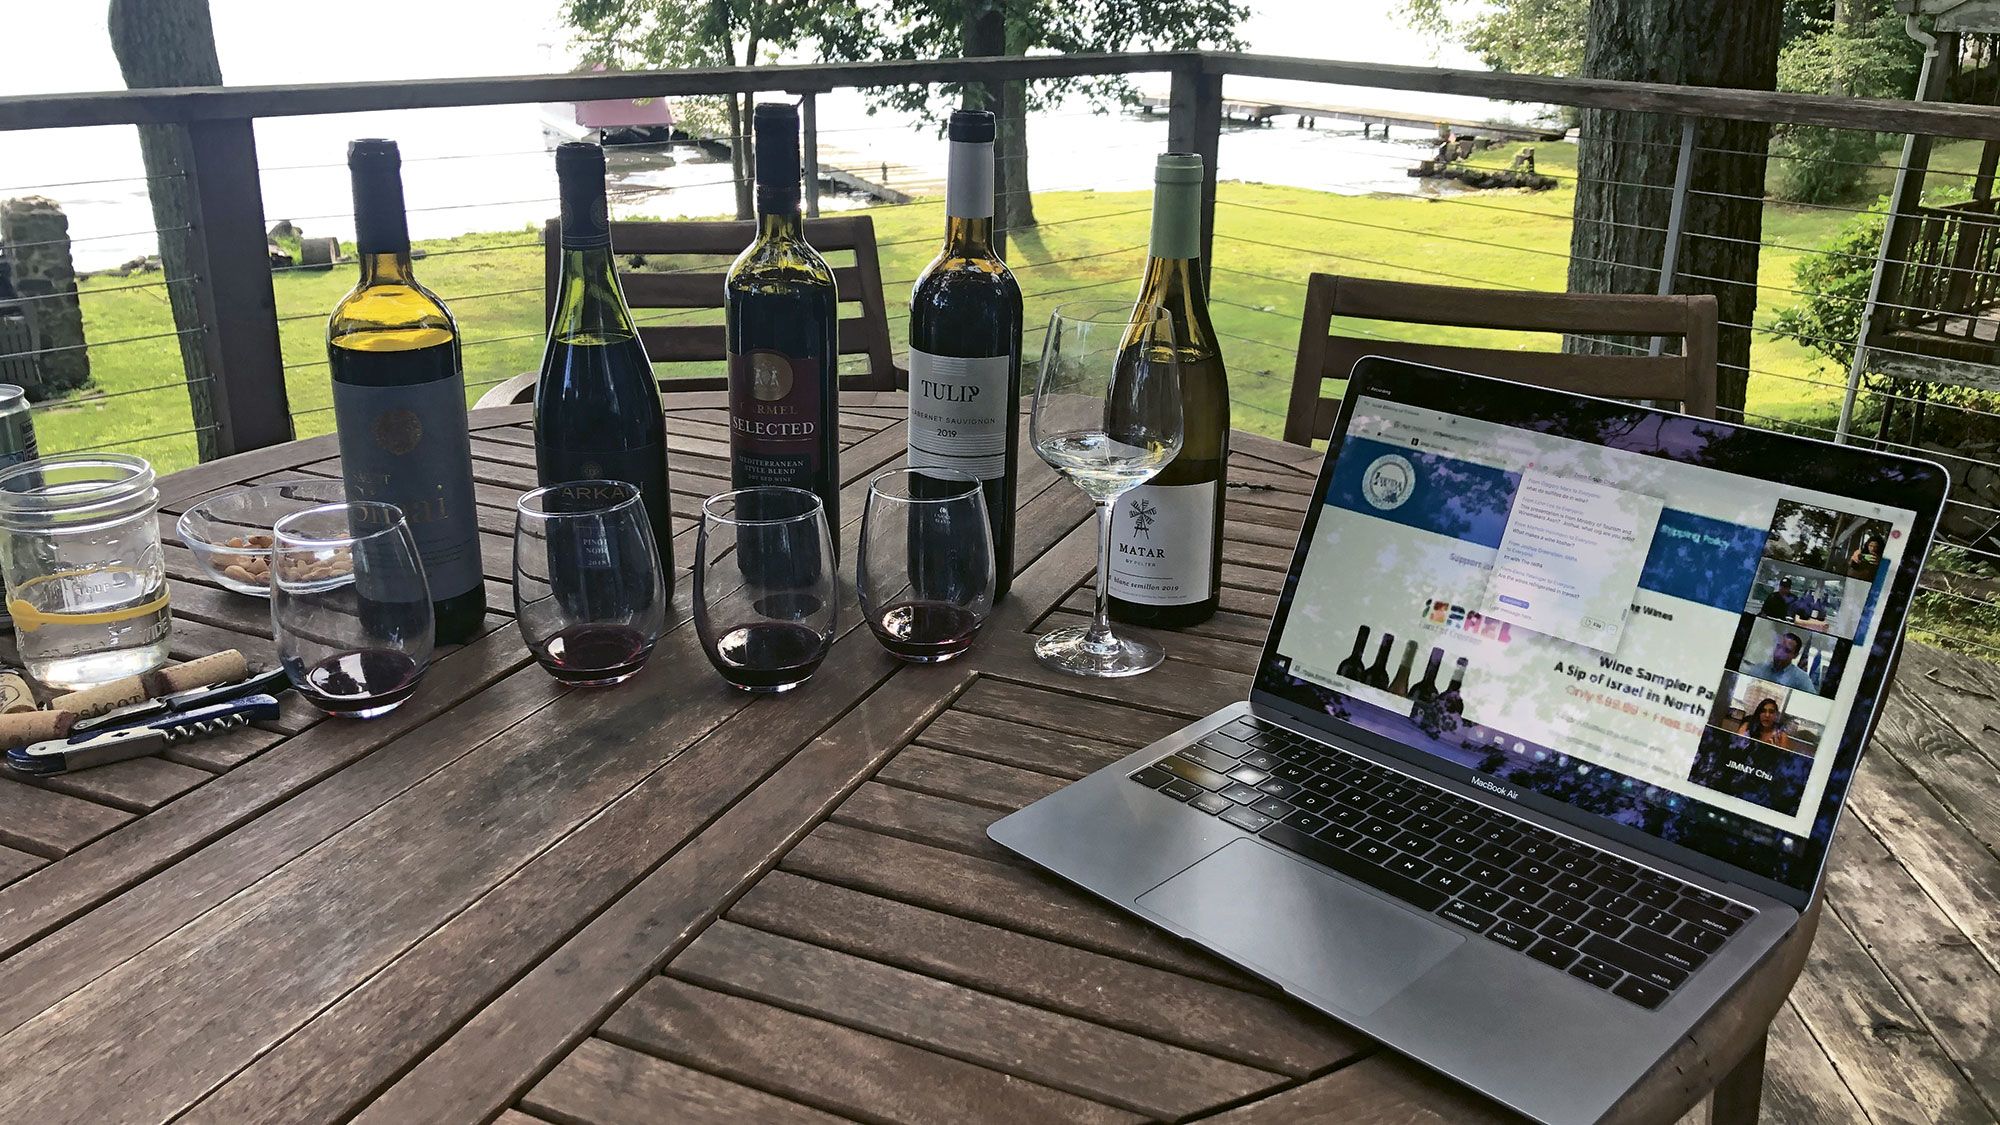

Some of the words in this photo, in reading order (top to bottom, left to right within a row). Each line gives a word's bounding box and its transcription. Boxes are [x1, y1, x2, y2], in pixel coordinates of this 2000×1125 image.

[921, 380, 980, 402] TULIP
[1371, 386, 1391, 395] Recording
[911, 408, 943, 422] CABERNET
[945, 417, 995, 425] SAUVIGNON
[733, 416, 815, 436] SELECTED
[937, 429, 957, 438] 2019
[739, 456, 804, 467] MEDITERRANEAN
[745, 465, 765, 474] STYLE
[768, 466, 796, 475] BLEND
[558, 481, 644, 500] ARKA
[1119, 543, 1165, 558] MATAR
[1449, 552, 1481, 568] Support
[1114, 576, 1129, 587] blanc
[1131, 582, 1160, 591] semillon
[1643, 605, 1673, 621] Wines
[1600, 656, 1633, 675] Wine
[1636, 668, 1694, 693] Sampler
[1554, 661, 1563, 673] A
[1567, 664, 1586, 681] Sip
[1590, 673, 1605, 685] of
[1606, 677, 1643, 698] Israel
[1646, 689, 1660, 703] in
[1664, 694, 1705, 717] North
[1565, 685, 1593, 702] Only
[1653, 712, 1681, 730] Free
[1725, 760, 1755, 774] JIMMY
[1755, 769, 1773, 781] Chu
[1166, 787, 1187, 798] control
[1471, 776, 1506, 796] MacBook
[1507, 790, 1519, 799] Air
[1404, 862, 1414, 870] N
[1440, 877, 1452, 885] M
[1444, 910, 1480, 928] command
[1702, 919, 1727, 931] delete
[1493, 931, 1518, 945] option
[1664, 952, 1690, 966] return
[1651, 973, 1671, 984] shift
